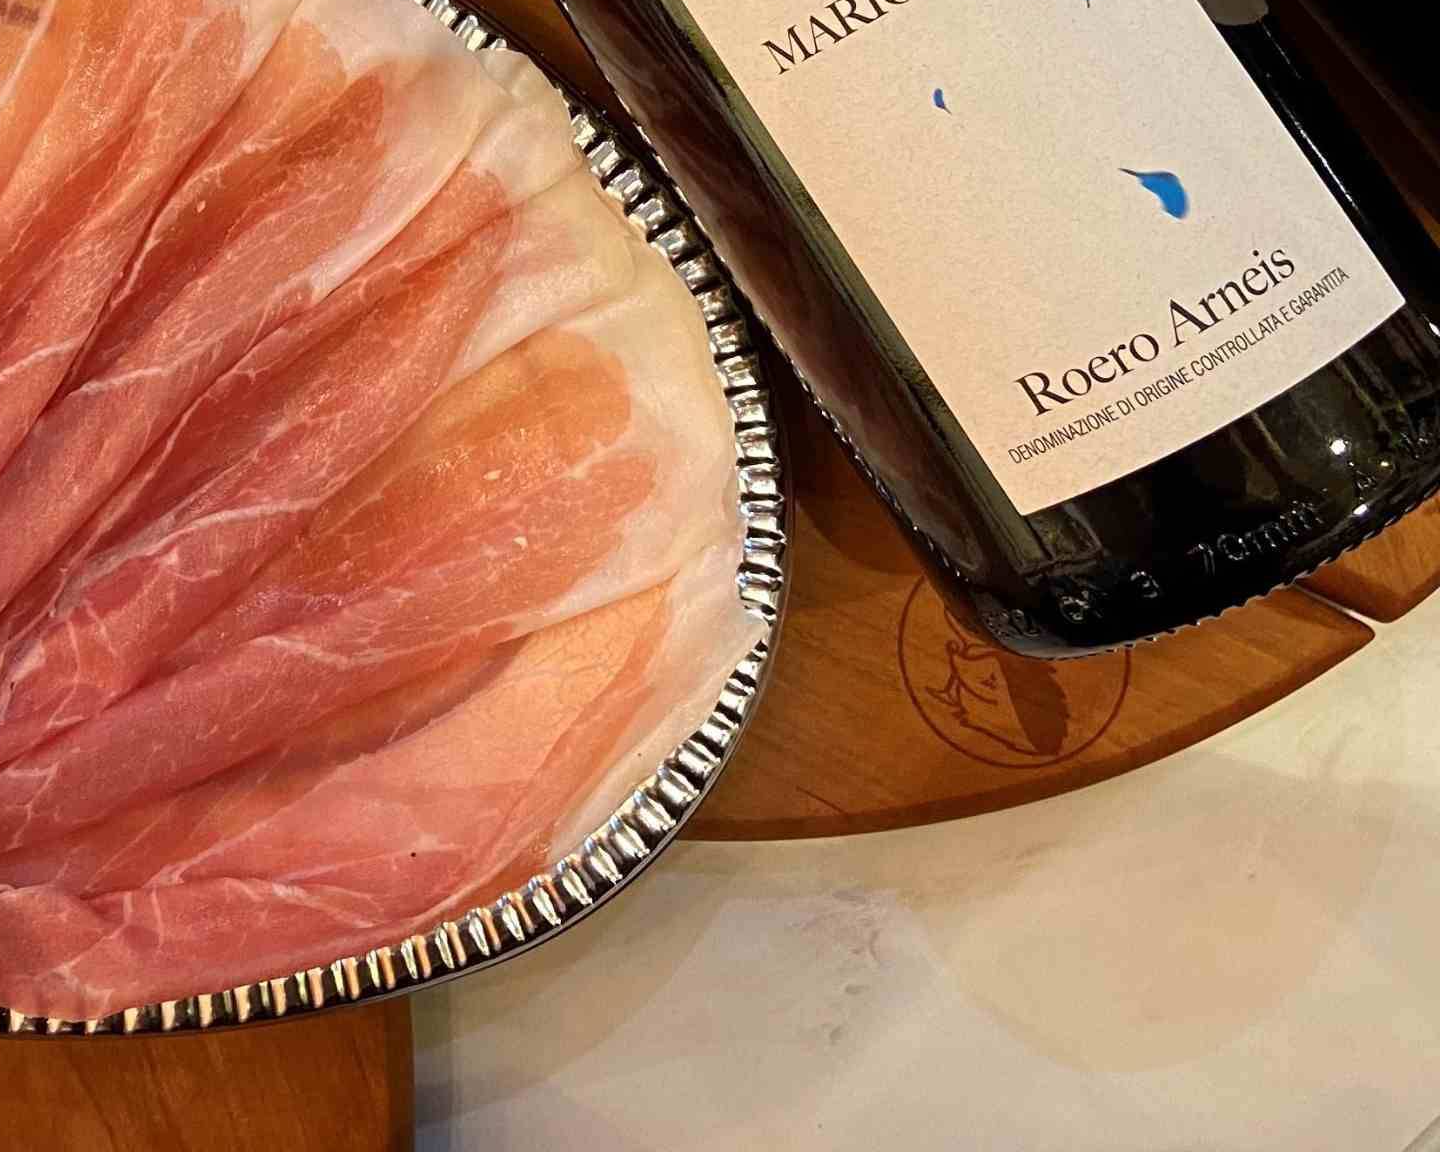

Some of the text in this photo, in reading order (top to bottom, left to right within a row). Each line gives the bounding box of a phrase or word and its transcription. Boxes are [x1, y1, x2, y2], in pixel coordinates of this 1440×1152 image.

[1007, 265, 1351, 465] DENOMINAZIONE DI ORIGINE CONTROLLATA E GARANTITA
[1014, 247, 1296, 417] Roero Arneis
